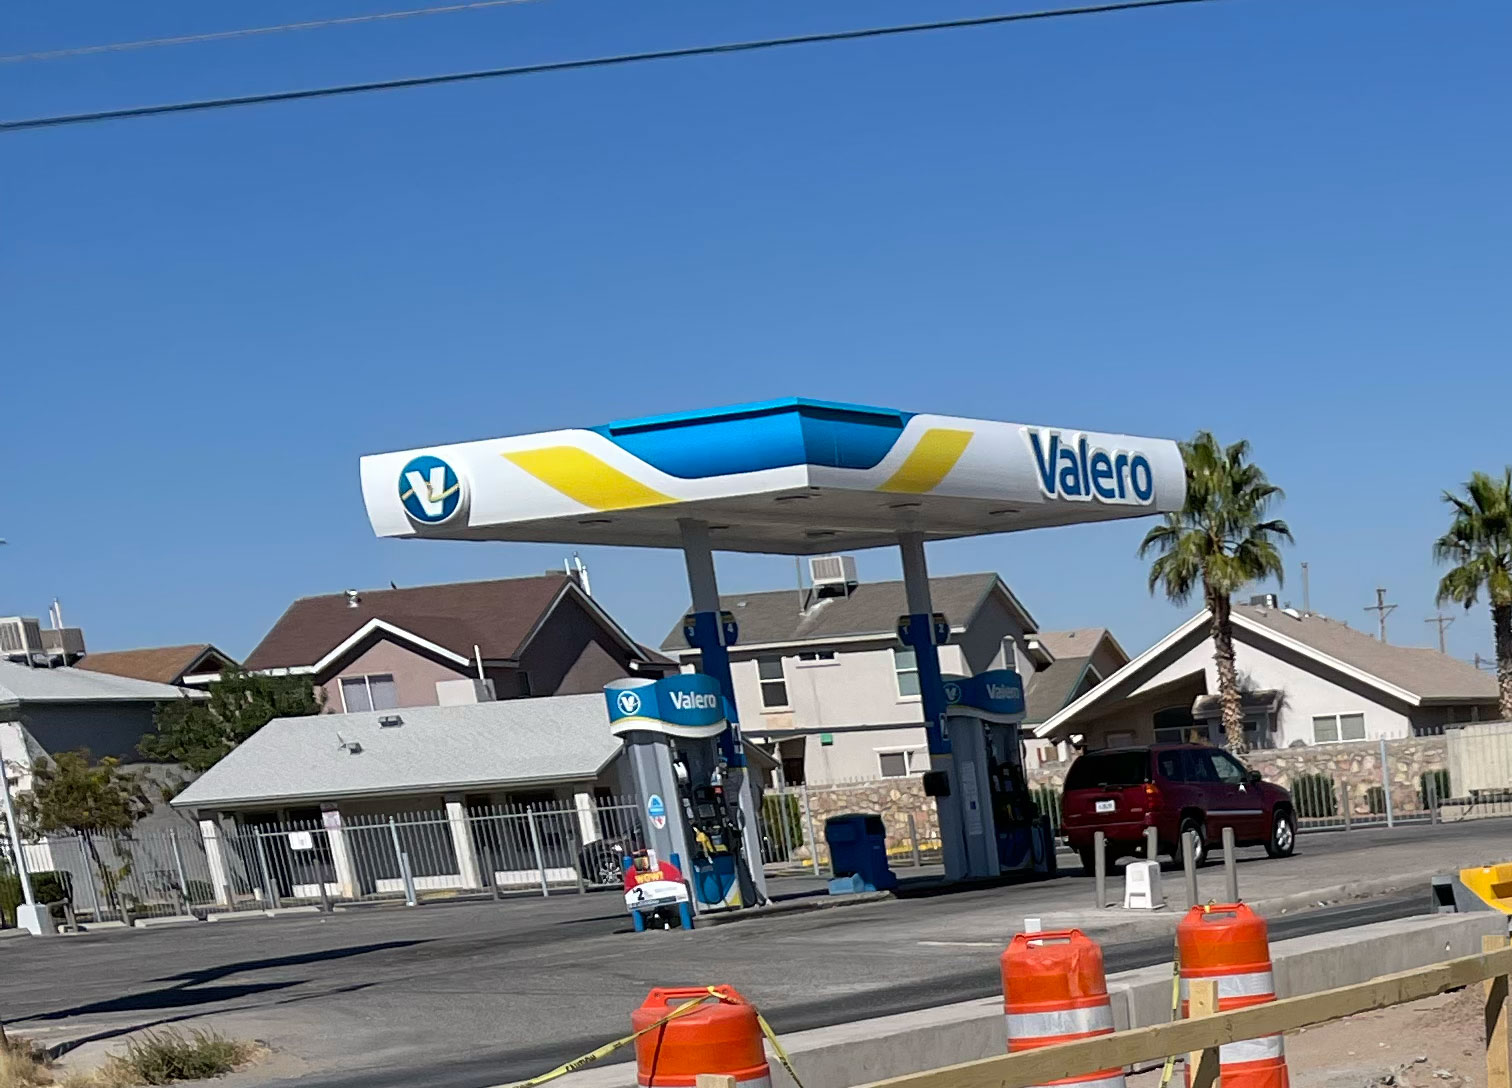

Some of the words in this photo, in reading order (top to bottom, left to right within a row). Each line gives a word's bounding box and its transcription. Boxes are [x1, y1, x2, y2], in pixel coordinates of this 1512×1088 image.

[404, 466, 446, 517] V
[1028, 430, 1154, 503] Valero
[669, 691, 717, 710] Valero
